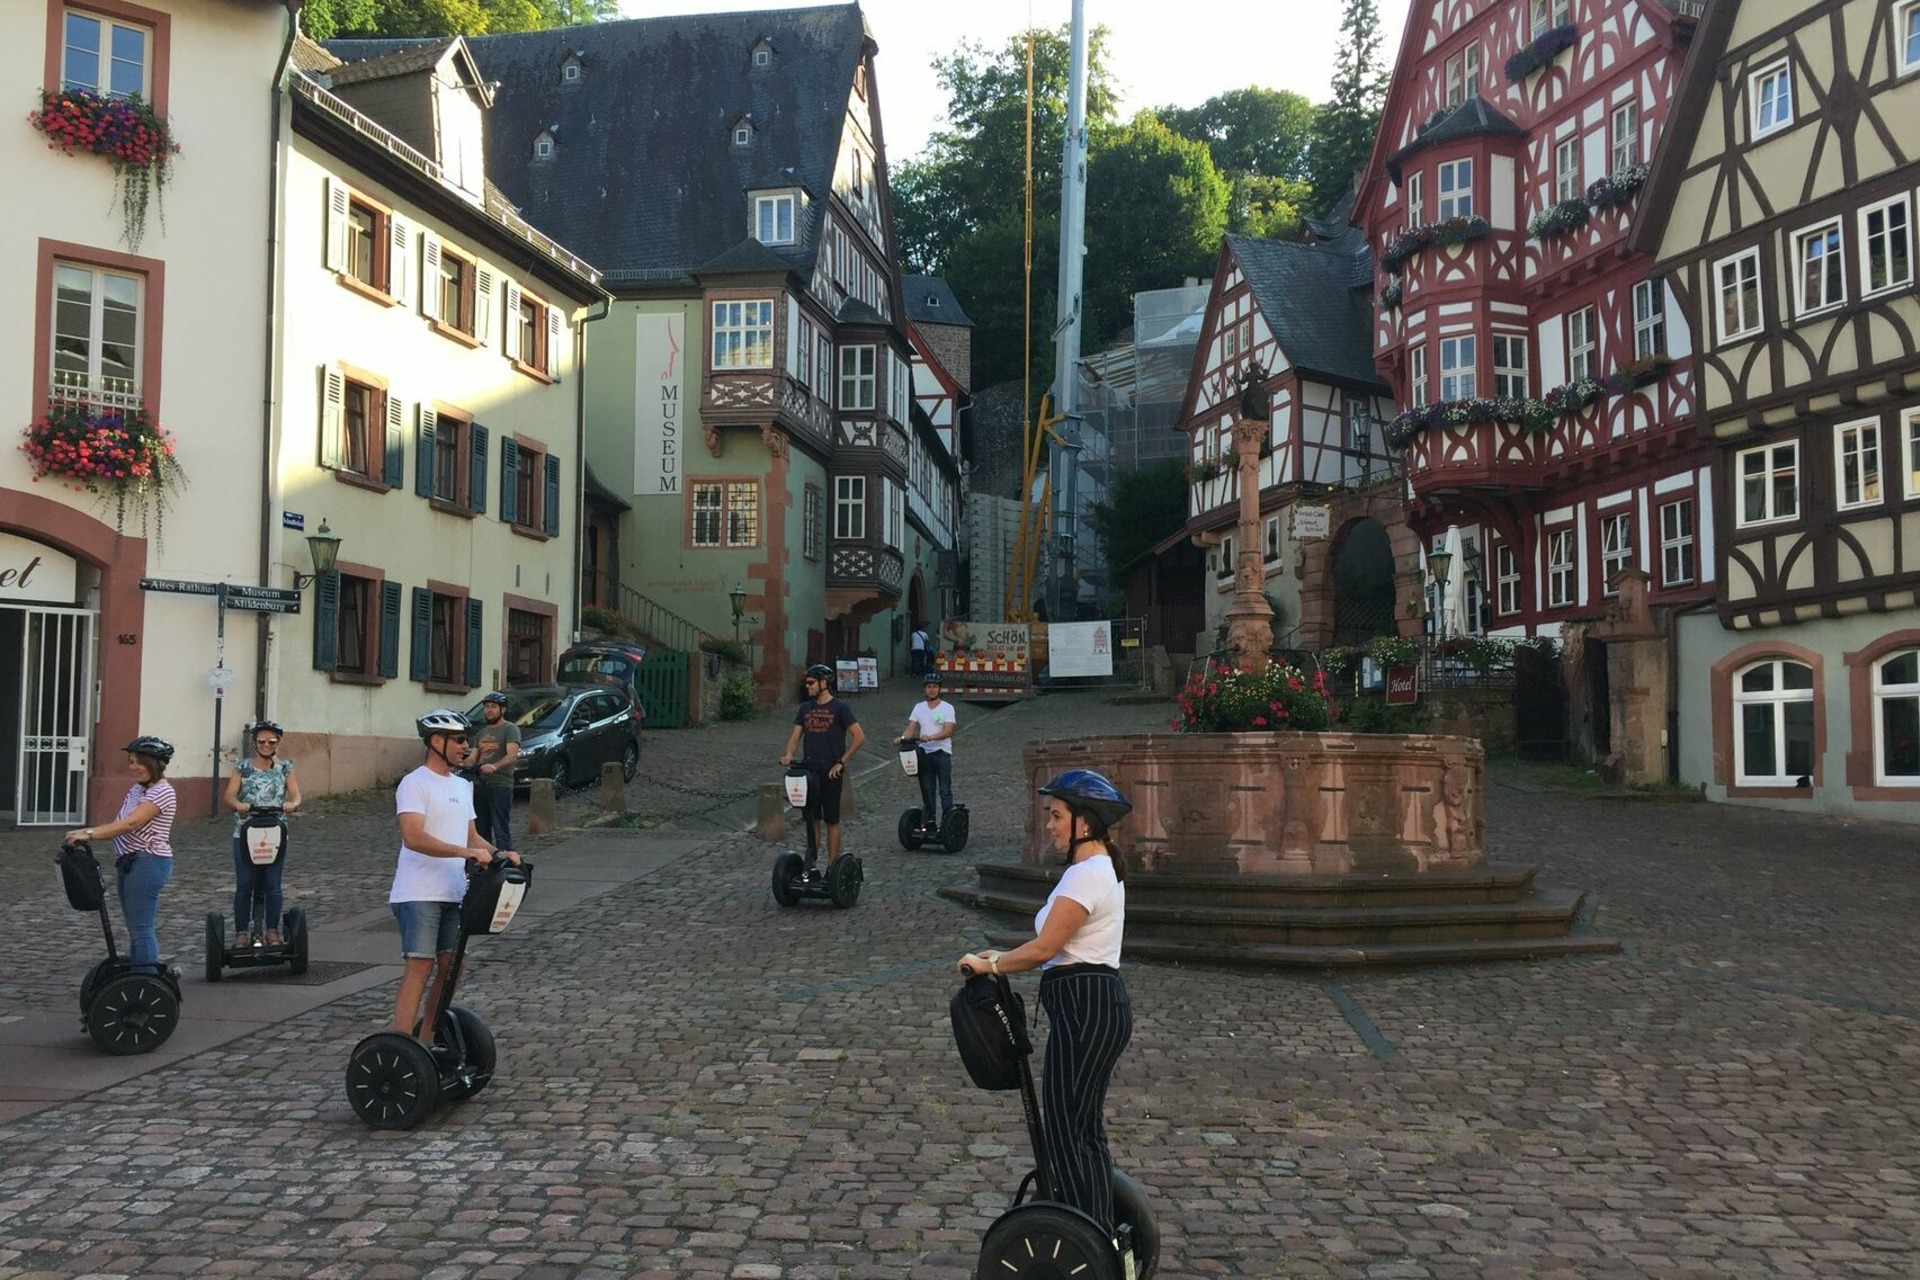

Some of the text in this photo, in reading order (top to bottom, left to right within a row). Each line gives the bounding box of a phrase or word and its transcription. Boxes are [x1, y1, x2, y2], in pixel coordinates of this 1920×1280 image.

[660, 385, 678, 492] MUSEUM
[150, 580, 215, 593] Altes Rathaus
[242, 587, 280, 599] Museum
[234, 599, 286, 612] Mildenburg
[116, 634, 136, 645] 165
[1390, 675, 1414, 693] Hotel
